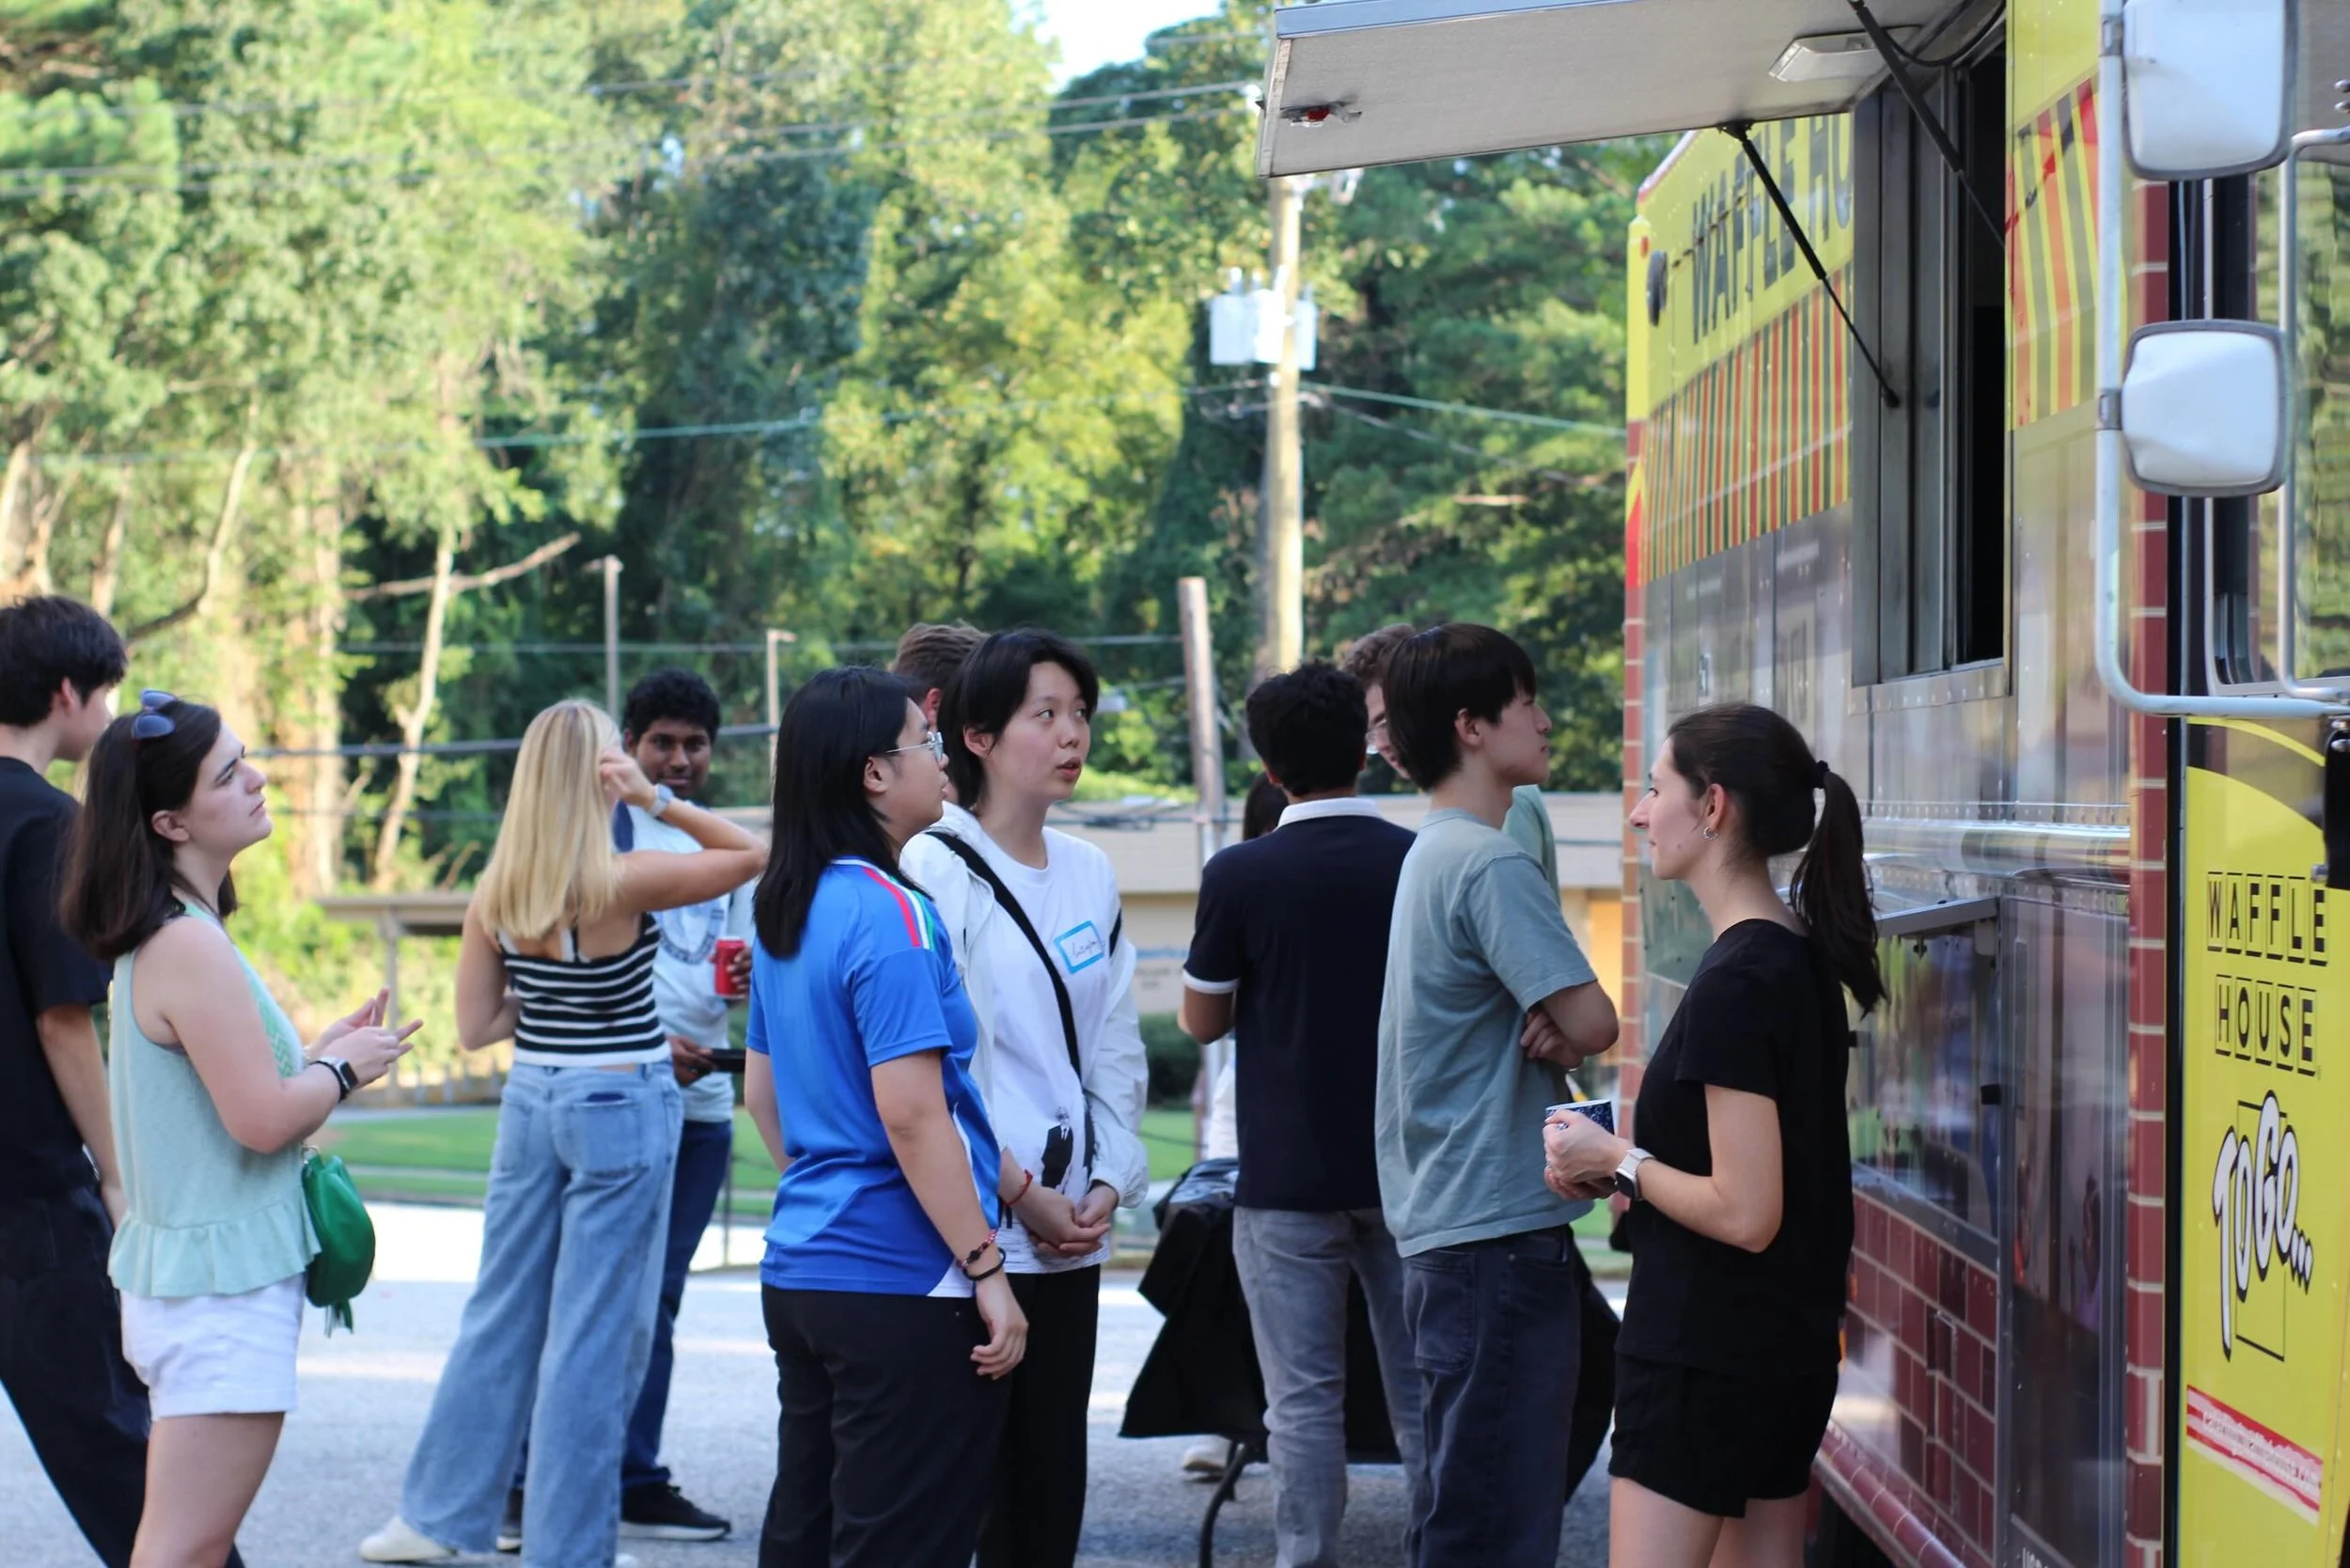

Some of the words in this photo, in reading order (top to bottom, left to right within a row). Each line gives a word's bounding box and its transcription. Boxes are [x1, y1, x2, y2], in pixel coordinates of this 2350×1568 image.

[1693, 118, 1796, 345] WAFFLE
[2207, 880, 2326, 954] WAFFLE
[2217, 983, 2314, 1063] HOUSE
